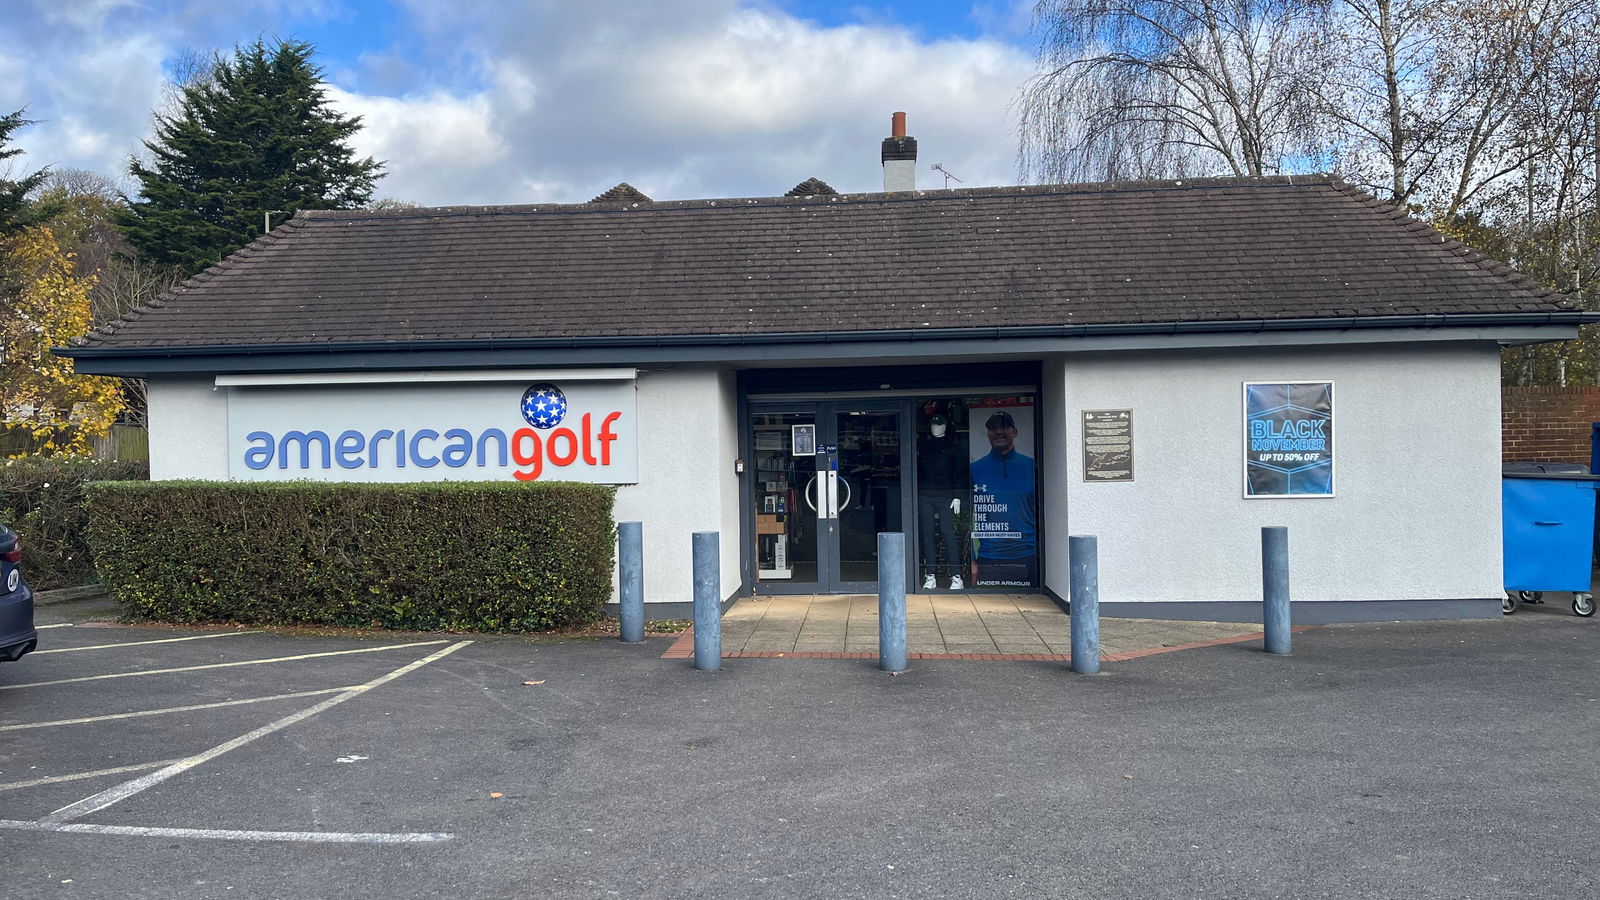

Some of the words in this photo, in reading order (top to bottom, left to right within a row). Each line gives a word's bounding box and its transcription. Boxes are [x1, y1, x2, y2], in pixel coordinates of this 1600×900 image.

[1251, 420, 1326, 438] BLACK
[1252, 438, 1326, 451] NOVEMBER
[1260, 453, 1272, 461] UP
[1272, 453, 1284, 461] TO
[1284, 453, 1303, 461] 50%
[1304, 453, 1320, 461] OFF
[973, 494, 995, 503] DRIVE
[973, 503, 1008, 512] THROUGH
[974, 513, 987, 521] THE
[974, 522, 1009, 531] ELEMENTS
